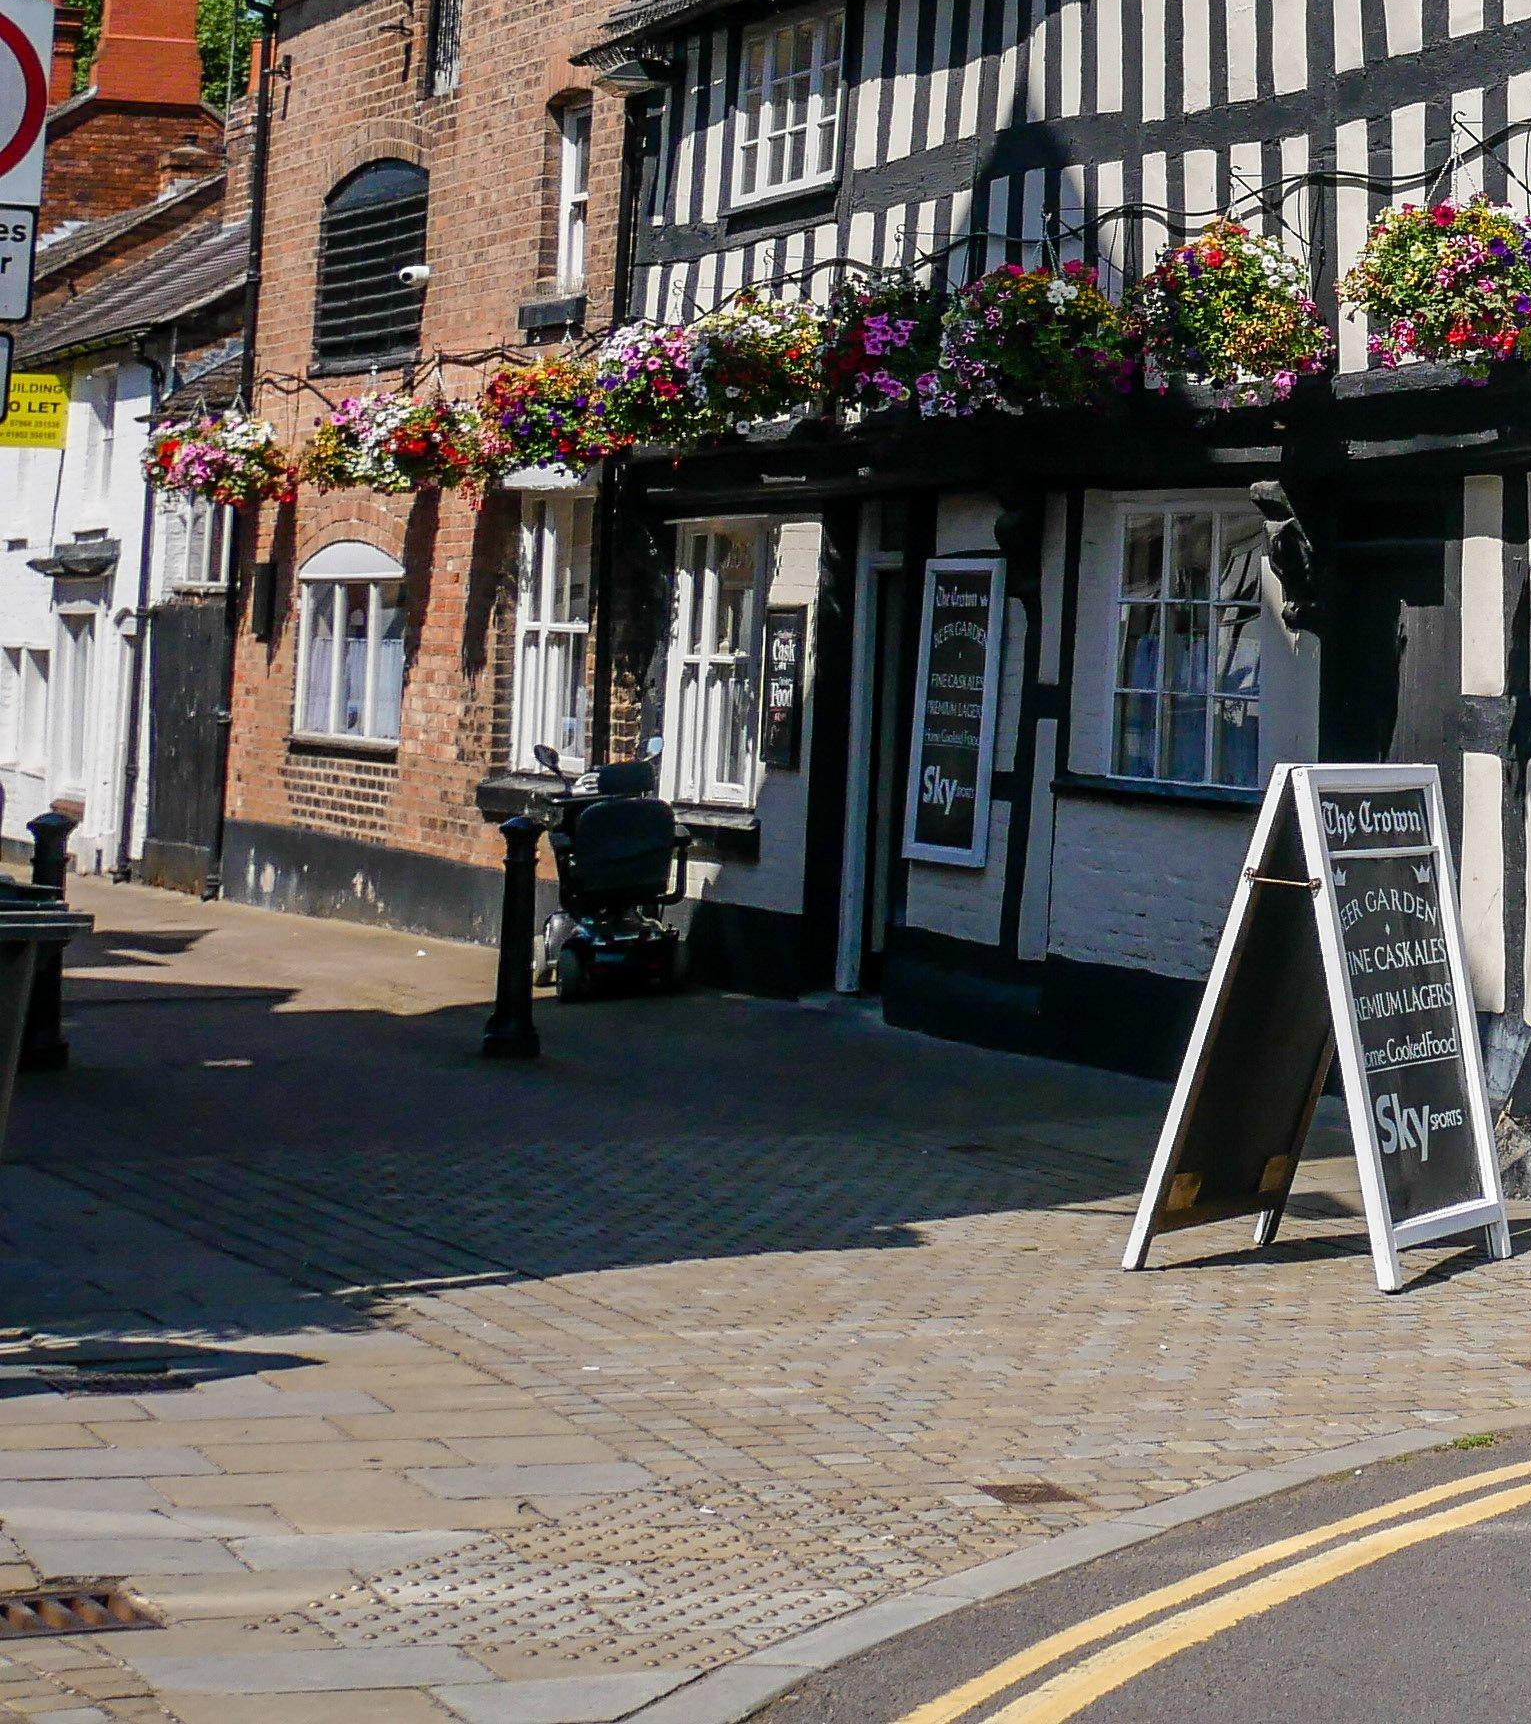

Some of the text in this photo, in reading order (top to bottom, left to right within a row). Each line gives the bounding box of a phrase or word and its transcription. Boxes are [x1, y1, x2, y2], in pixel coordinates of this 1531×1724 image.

[9, 401, 61, 413] O LET
[11, 383, 63, 394] UILDING
[922, 765, 958, 816] Sky
[1321, 800, 1422, 845] The Crown
[1340, 888, 1437, 932] EER GARDEN
[1348, 937, 1447, 976] INE CASK ALES
[1354, 982, 1454, 1022] REMIUM LAGERS
[1364, 1028, 1457, 1068] ome Cooked Food
[1375, 1093, 1463, 1162] Sky SPORTS
